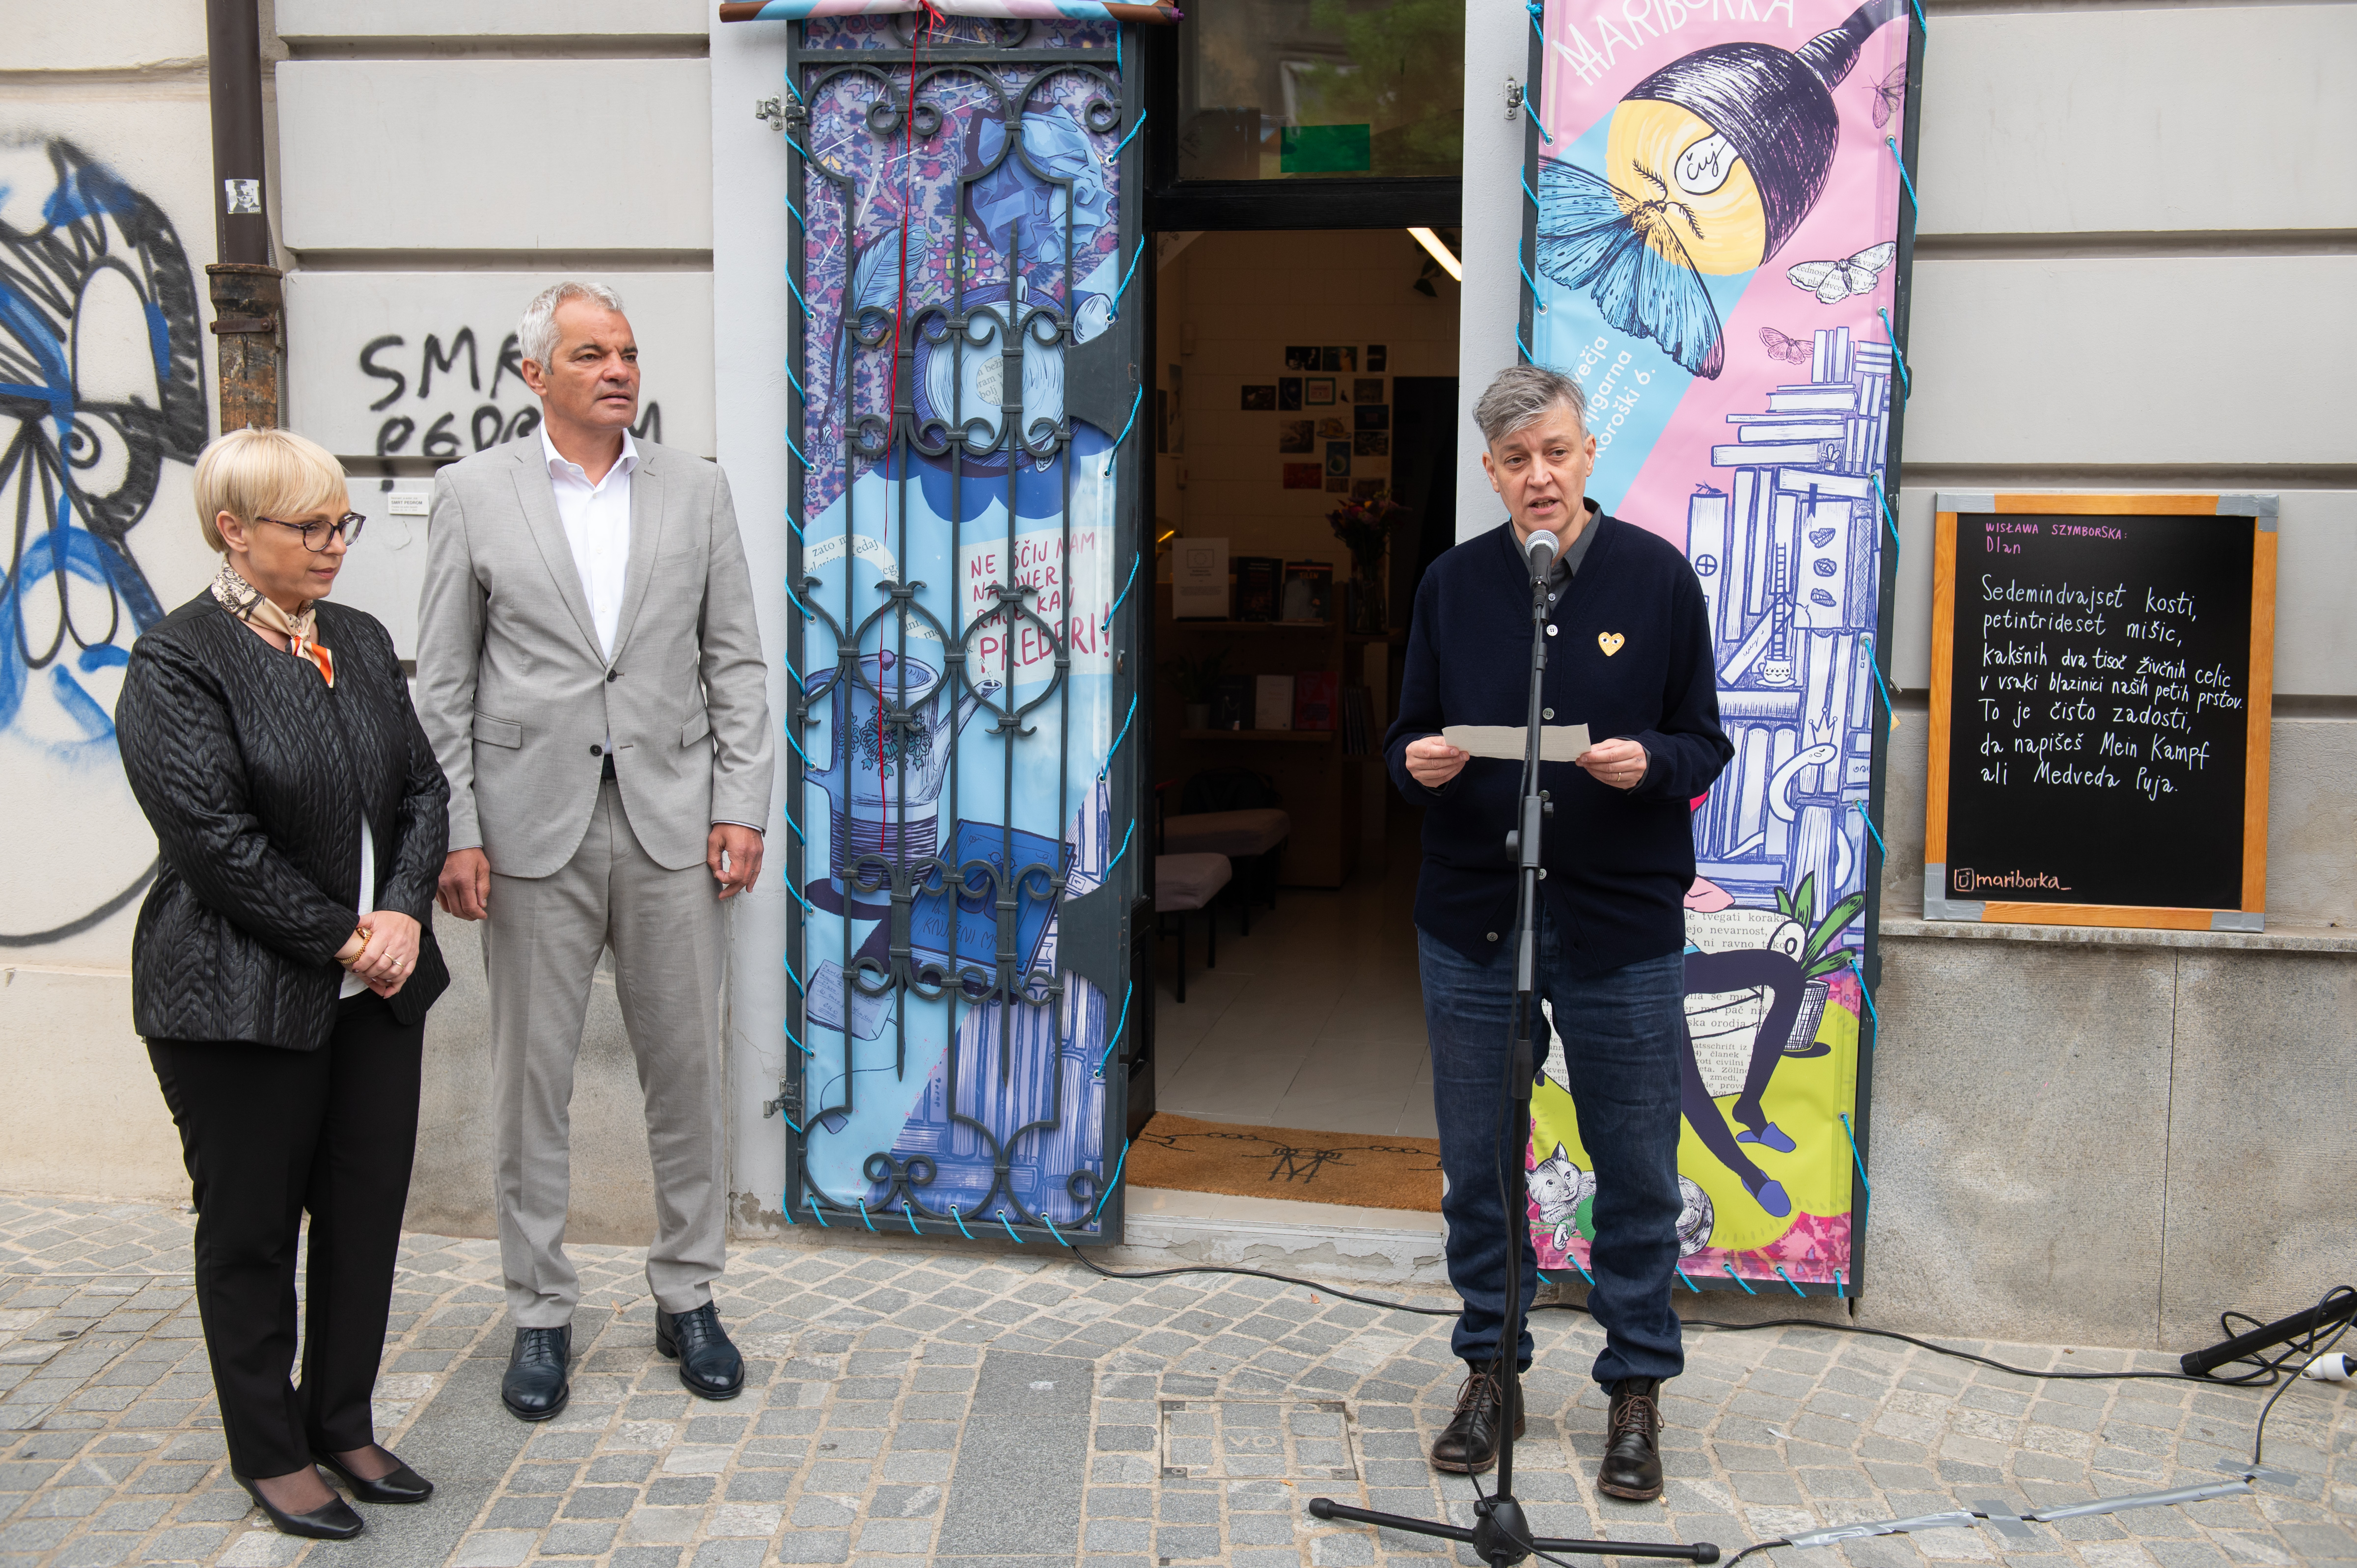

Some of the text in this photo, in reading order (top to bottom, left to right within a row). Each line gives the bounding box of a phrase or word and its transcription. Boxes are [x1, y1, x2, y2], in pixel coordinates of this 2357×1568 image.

[1551, 0, 1794, 86] MARIBA
[360, 325, 527, 411] SMR
[1595, 369, 1656, 459] Koroški 6.
[1986, 523, 2127, 540] WISŁAWA SZYMBORSKA:
[1987, 536, 2020, 554] Dlan
[812, 542, 835, 557] zato
[972, 554, 996, 578] NE
[1056, 532, 1095, 559] NAM
[974, 580, 1000, 602] NA
[1037, 587, 1075, 615] KAJ
[1982, 574, 2196, 624] Sedemindvajset kosti,
[1984, 609, 2182, 647] petintrideset mišic,
[1983, 641, 2231, 687] kakšnih dva tisoč živčnih celic
[1981, 672, 2242, 713] v vsaki blazinici naših petih prstov.
[1978, 697, 2191, 734] To je čisto zadosti,
[1981, 732, 2209, 770] da napišeš Mein Kampf
[1981, 762, 2178, 801] ali Medveda Puja.
[1702, 912, 1740, 922] tvegati
[1748, 913, 1786, 922] koraka
[1710, 927, 1767, 937] nevarnost,
[1762, 940, 1785, 949] tko
[1711, 1019, 1745, 1028] orodja
[1725, 1006, 1743, 1015] pač
[1228, 1435, 1277, 1447] VO
